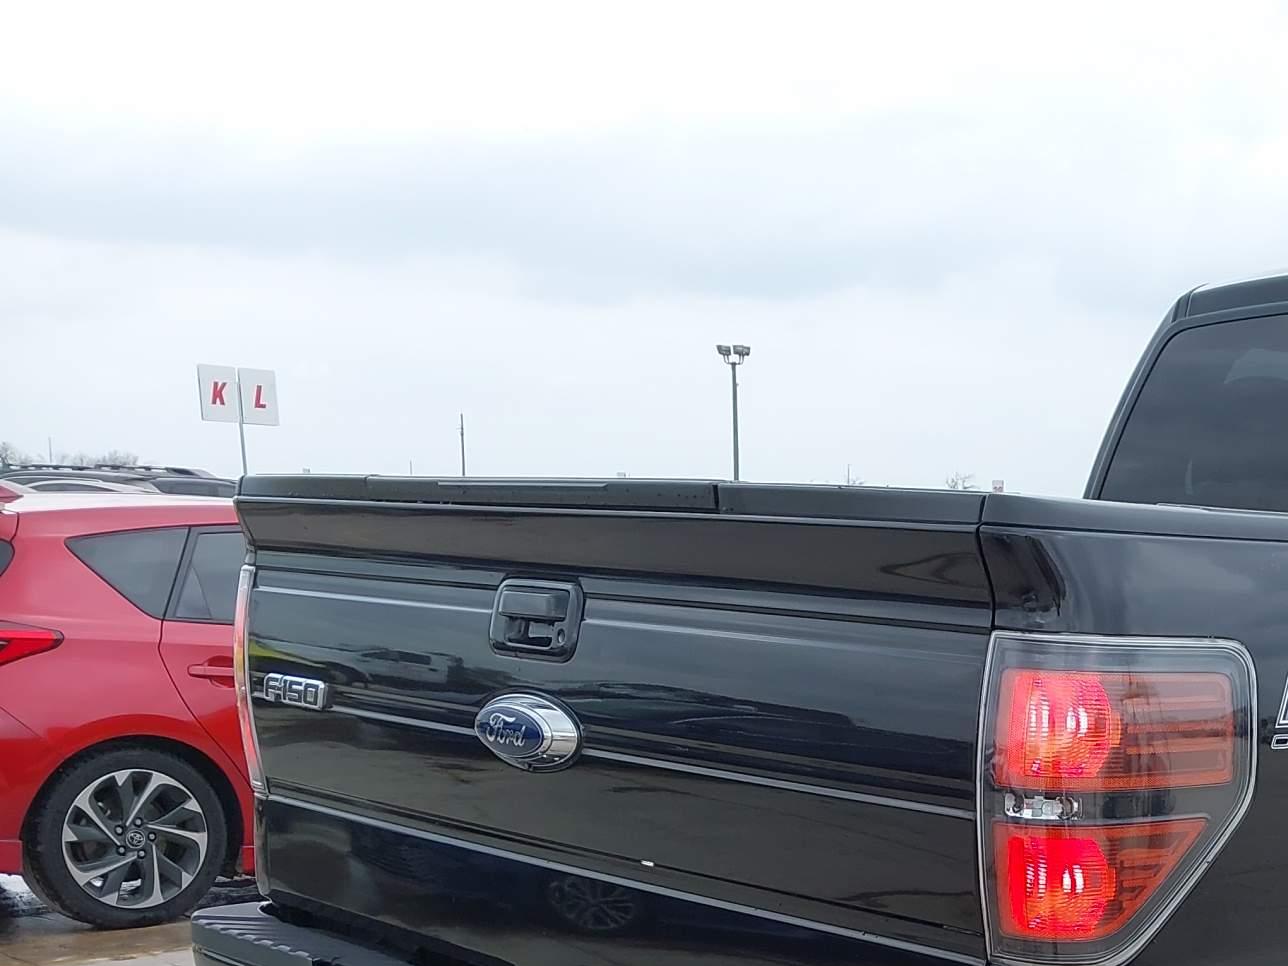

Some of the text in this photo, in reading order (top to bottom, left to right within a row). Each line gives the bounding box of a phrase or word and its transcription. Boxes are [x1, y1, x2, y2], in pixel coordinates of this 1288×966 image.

[211, 380, 228, 406] K
[254, 384, 267, 409] L
[486, 713, 526, 747] Ford
